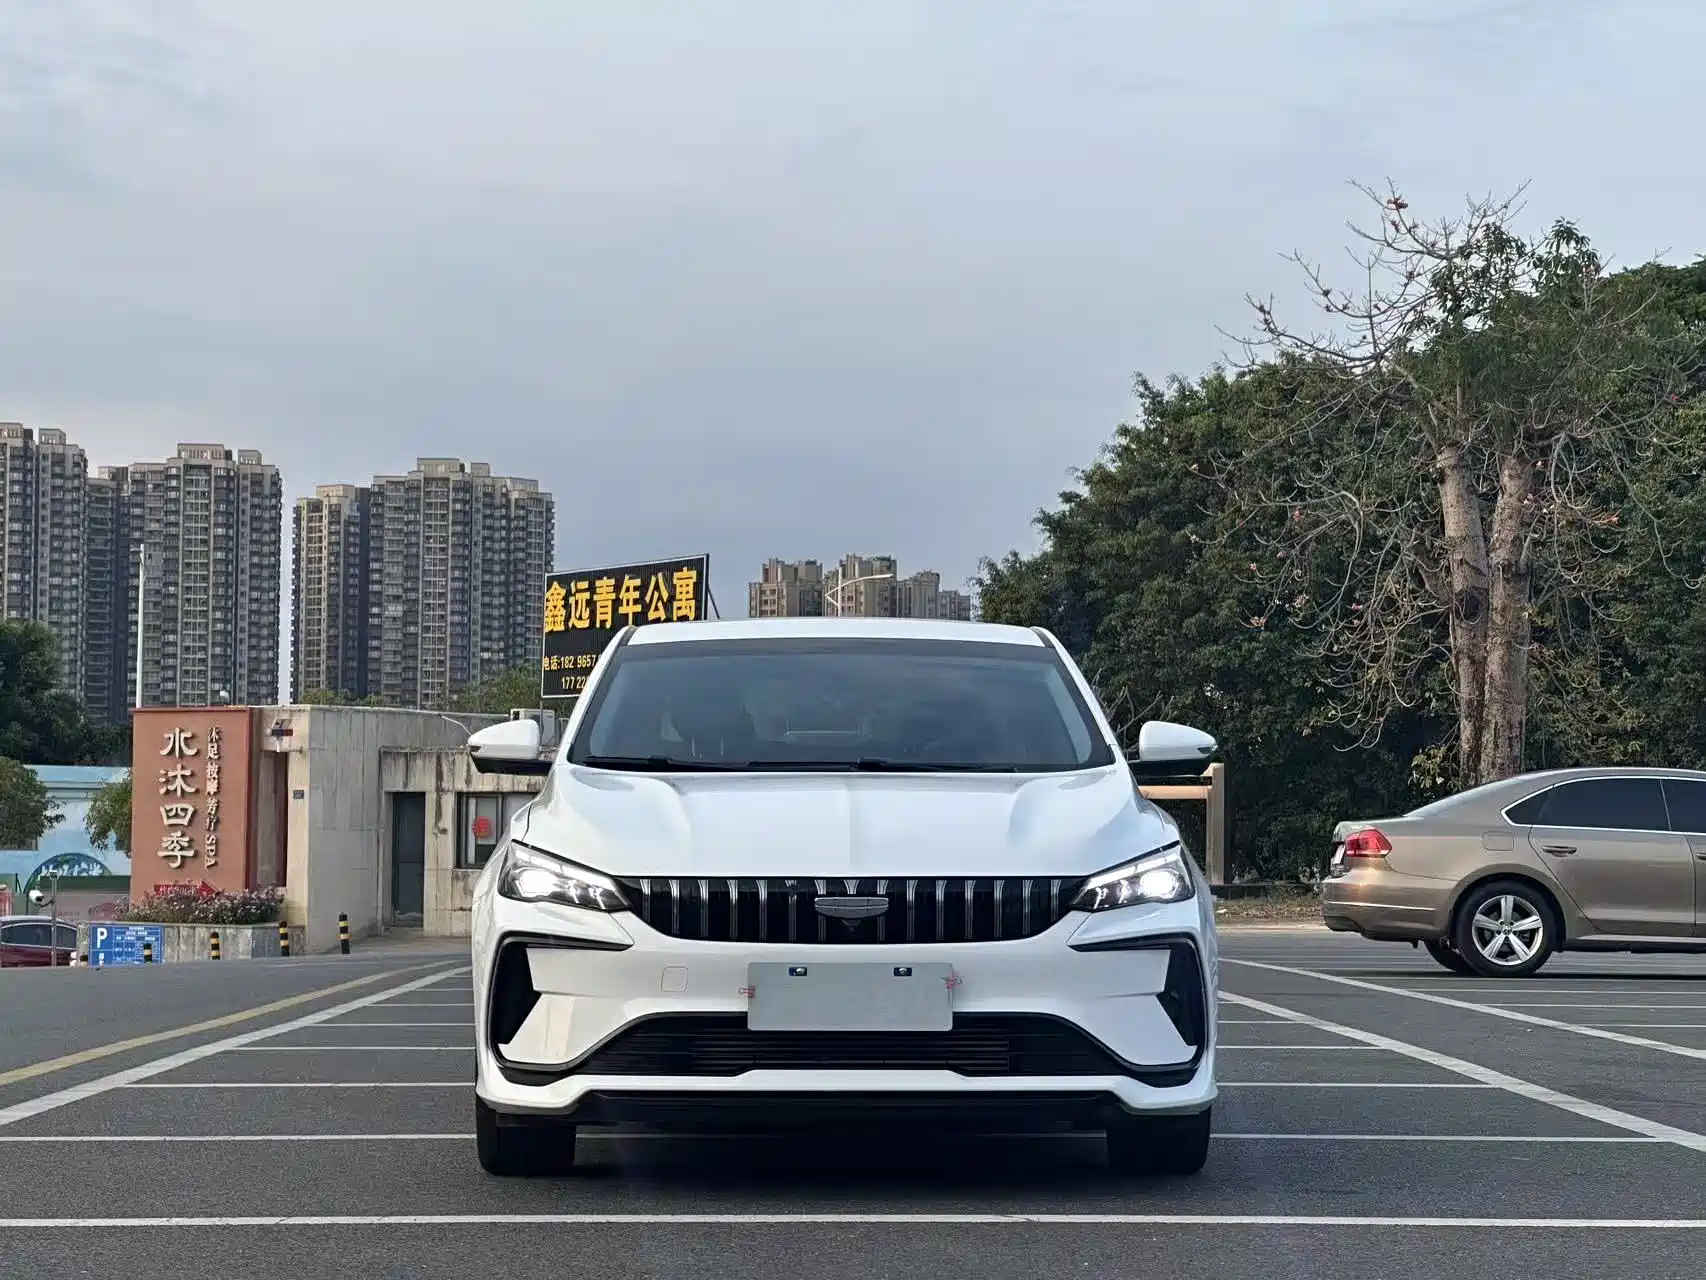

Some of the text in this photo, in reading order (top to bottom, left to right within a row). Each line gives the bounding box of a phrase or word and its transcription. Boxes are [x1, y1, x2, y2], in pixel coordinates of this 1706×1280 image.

[544, 566, 697, 633] 鑫远青年公寓
[561, 675, 590, 689] 177 22
[157, 727, 198, 869] 水沐四季
[96, 927, 108, 949] P
